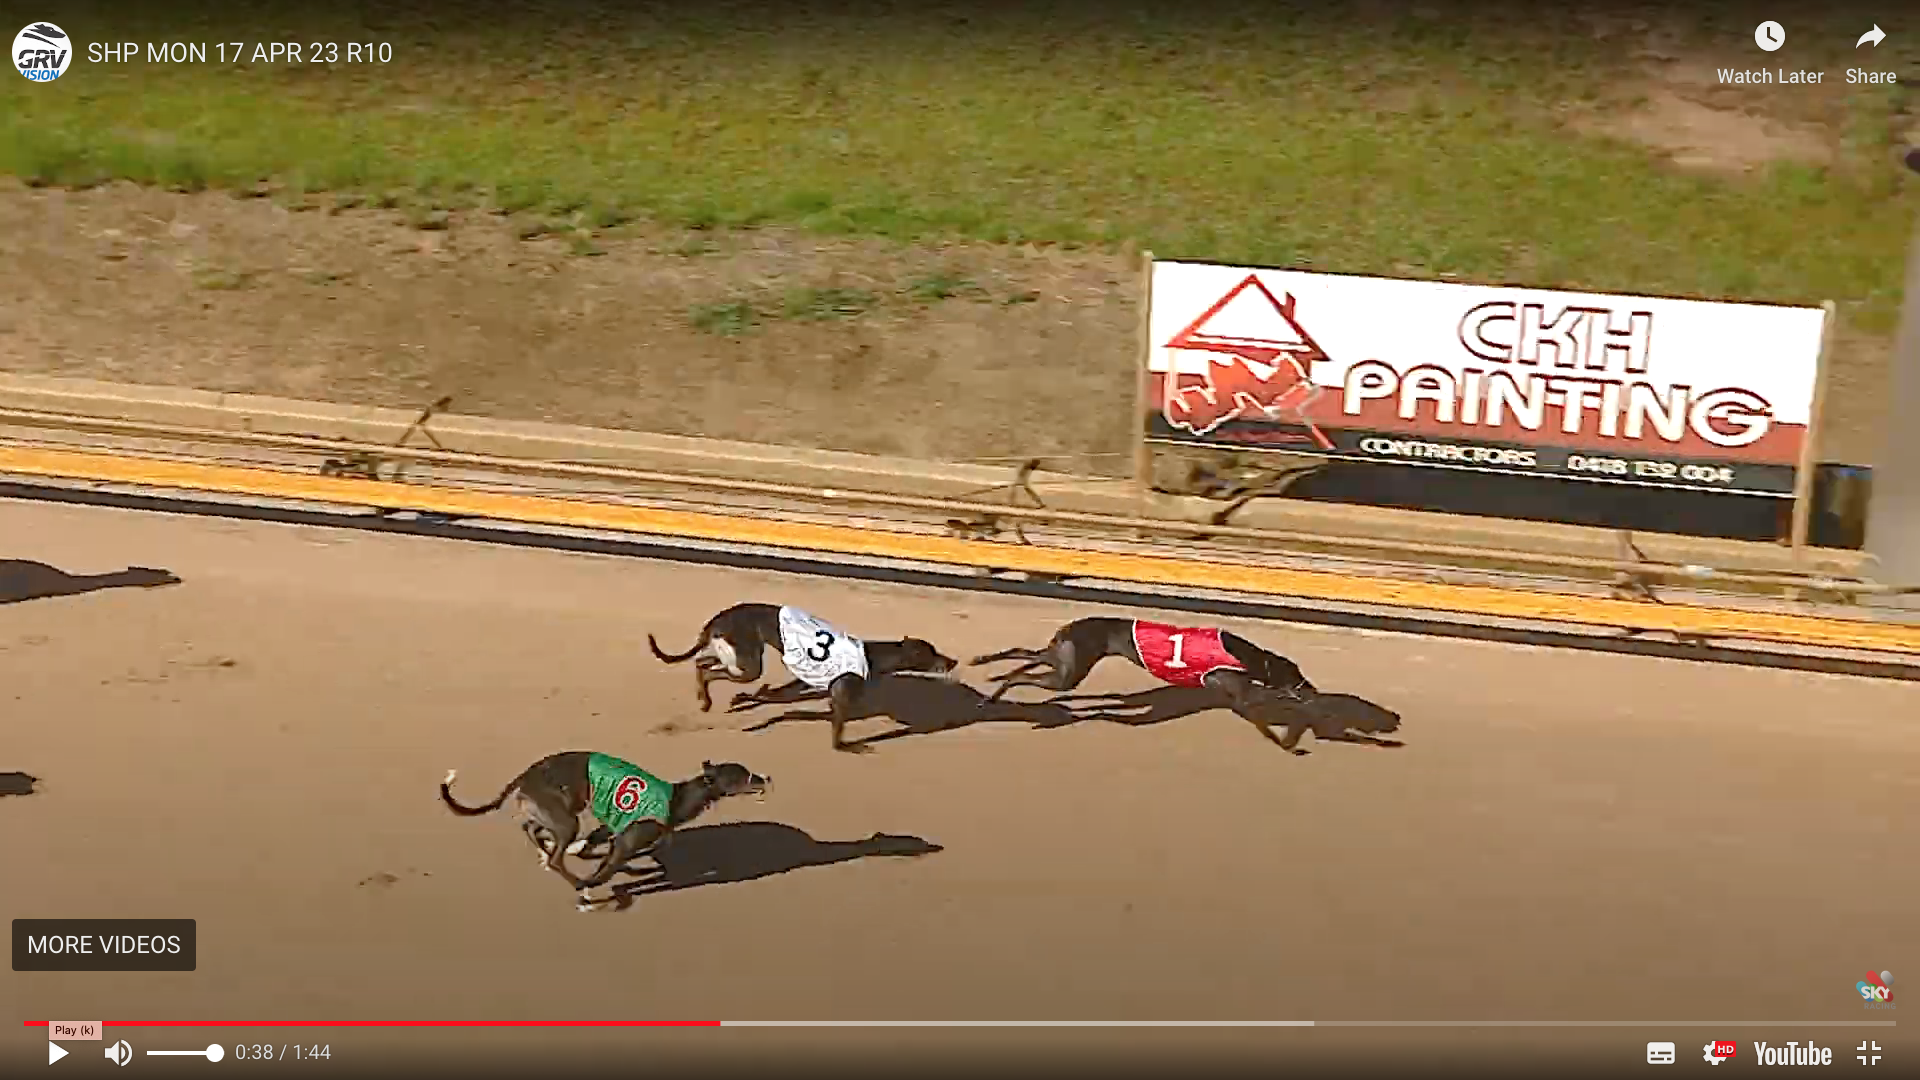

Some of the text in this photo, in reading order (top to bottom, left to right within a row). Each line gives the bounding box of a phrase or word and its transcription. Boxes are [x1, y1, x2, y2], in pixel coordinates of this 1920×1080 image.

[1458, 301, 1653, 373] CKH
[1343, 359, 1774, 447] PAINTING
[807, 630, 835, 661] 3
[1164, 634, 1188, 668] 1
[613, 776, 648, 813] 6
